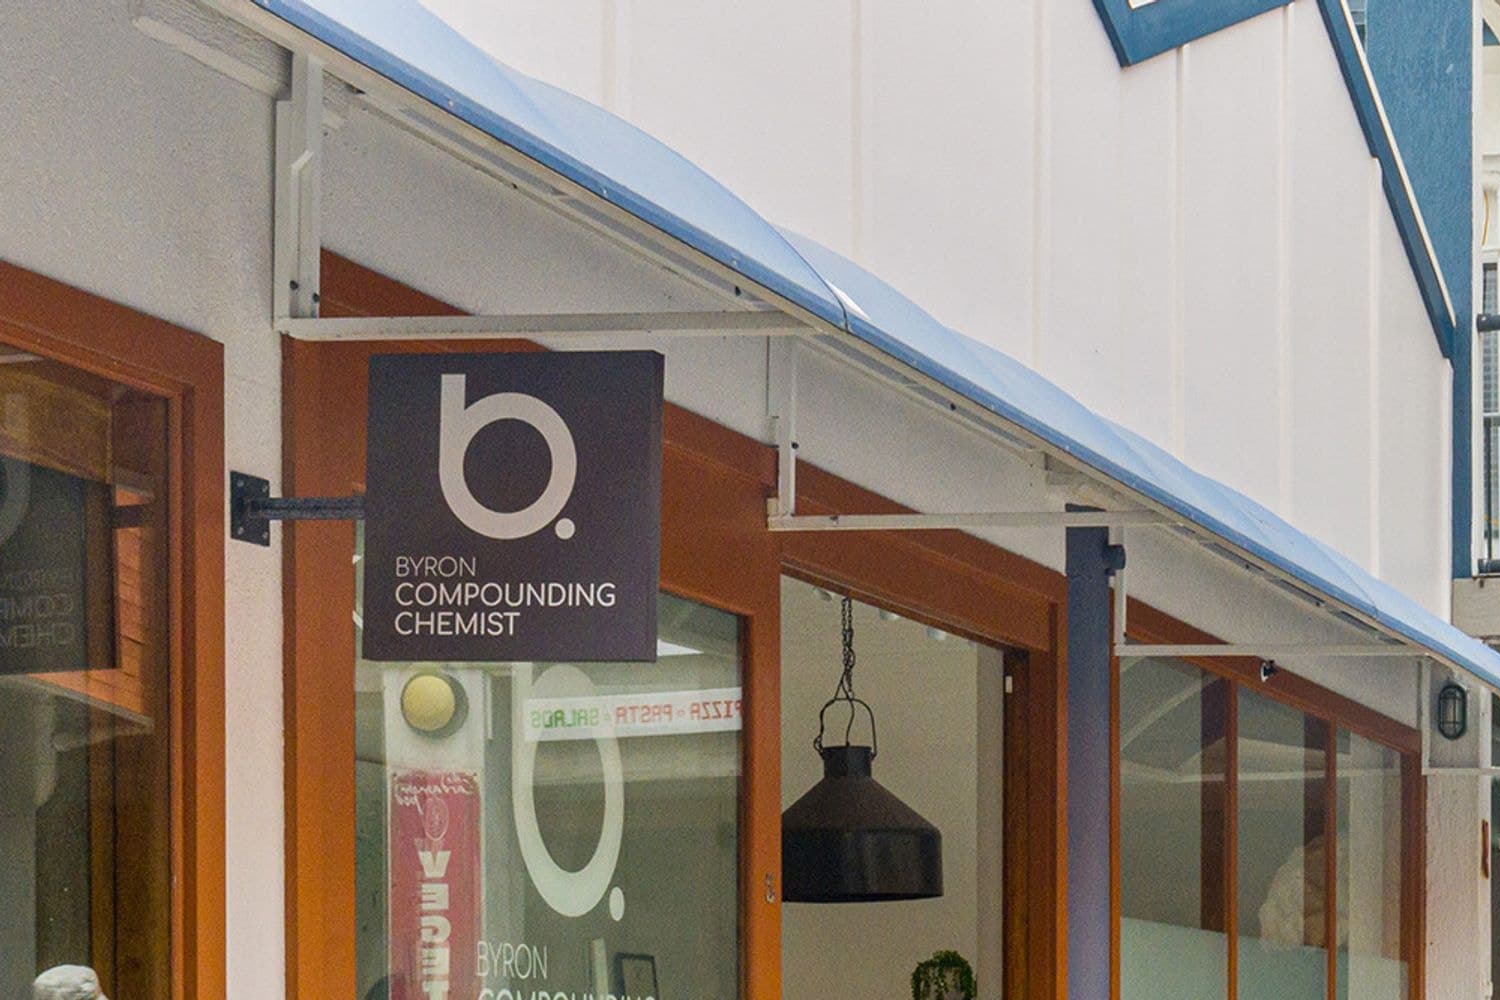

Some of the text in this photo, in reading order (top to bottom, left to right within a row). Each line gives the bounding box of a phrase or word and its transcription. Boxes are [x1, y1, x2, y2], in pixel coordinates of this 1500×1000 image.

[395, 556, 477, 578] BYRON
[394, 582, 616, 607] COMPOUNDING
[394, 611, 521, 636] CHEMIST
[476, 941, 549, 979] BYRON
